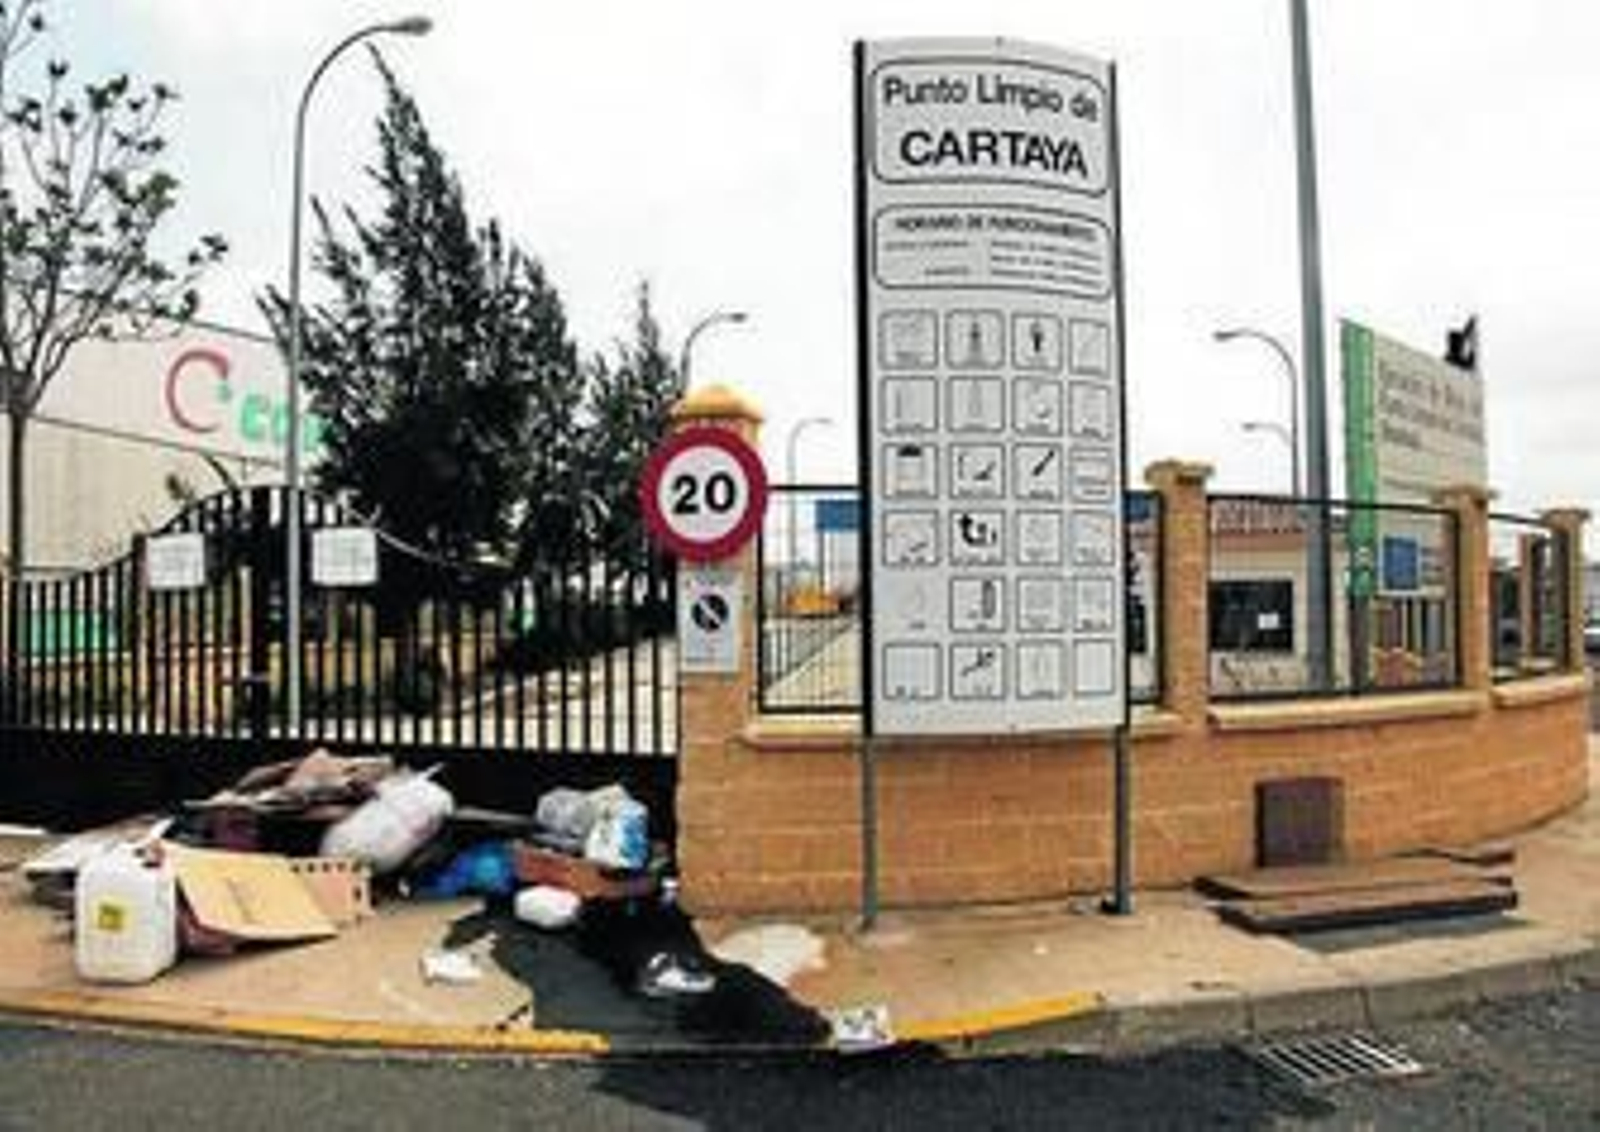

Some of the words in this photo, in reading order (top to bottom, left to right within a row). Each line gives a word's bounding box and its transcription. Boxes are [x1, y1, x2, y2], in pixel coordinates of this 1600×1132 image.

[883, 75, 967, 104] Punto
[976, 74, 1064, 114] Limpio
[900, 130, 1088, 180] CARTAYA
[672, 471, 736, 514] 20
